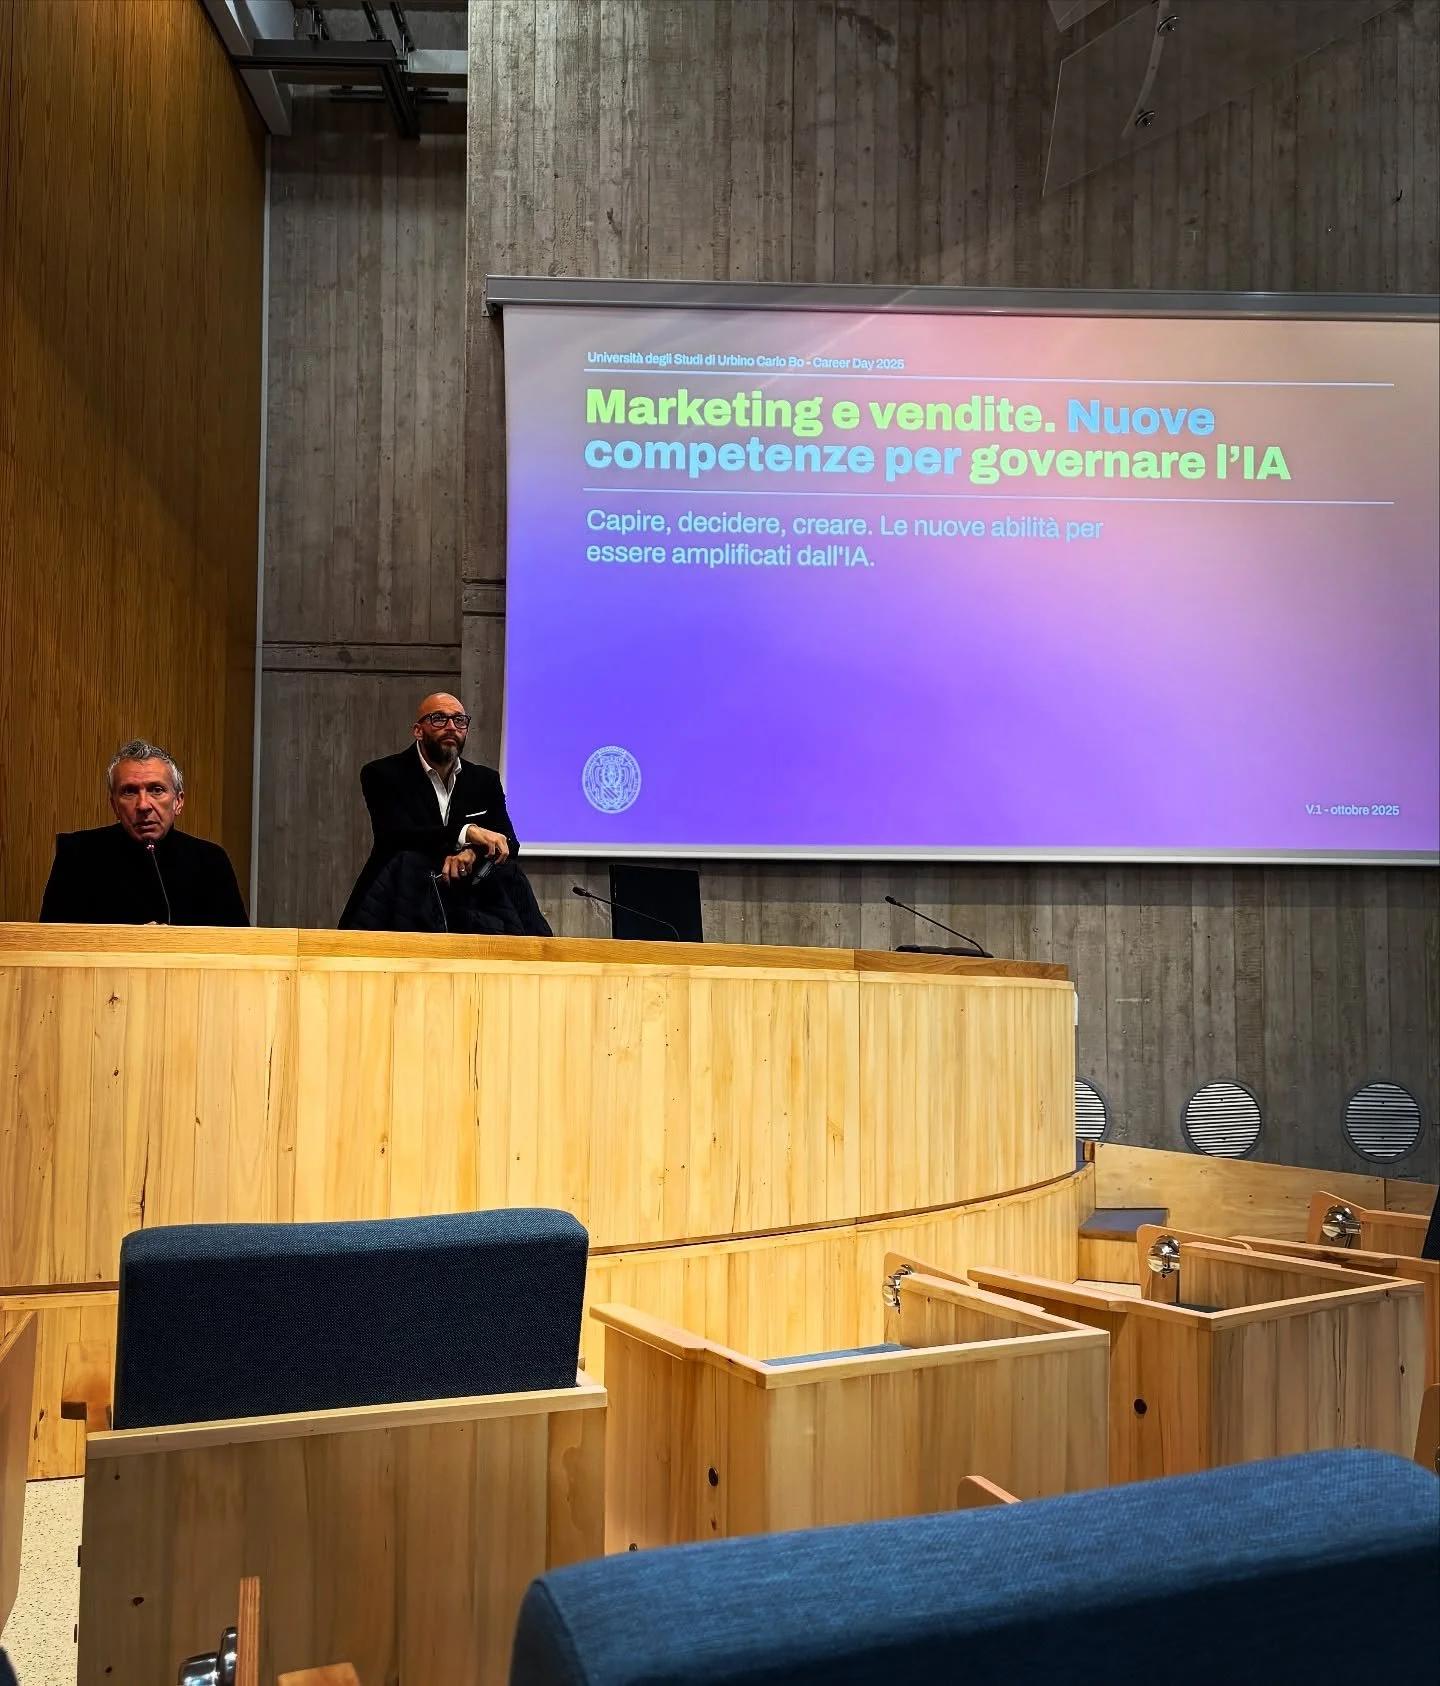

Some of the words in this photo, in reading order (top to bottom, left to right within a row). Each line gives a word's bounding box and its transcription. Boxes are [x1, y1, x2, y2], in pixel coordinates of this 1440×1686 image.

[587, 351, 643, 364] Università
[645, 352, 672, 366] degli
[674, 353, 702, 365] Studi
[705, 354, 715, 365] di
[718, 354, 754, 366] Urbino
[756, 355, 785, 367] Carlo
[788, 356, 804, 367] Bo
[813, 357, 850, 368] Career
[852, 358, 874, 371] Day
[876, 358, 905, 369] 2025
[586, 388, 824, 437] Marketing
[831, 401, 860, 429] e
[869, 395, 1055, 433] vendite.
[1067, 398, 1216, 436] Nuove
[584, 437, 875, 478] competenze
[885, 445, 962, 482] per
[969, 444, 1206, 484] governare
[1216, 443, 1292, 480] l’IA
[586, 509, 672, 536] Capire,
[678, 511, 786, 538] decidere,
[792, 516, 873, 536] creare.
[880, 515, 908, 536] Le
[914, 519, 985, 537] nuove
[990, 516, 1060, 539] abilità
[1066, 520, 1104, 542] per
[586, 543, 666, 563] essere
[671, 543, 791, 568] amplificati
[797, 545, 875, 567] dall'IA.
[1305, 804, 1321, 815] V.1
[1330, 805, 1369, 815] ottobre
[1371, 805, 1400, 816] 2025
